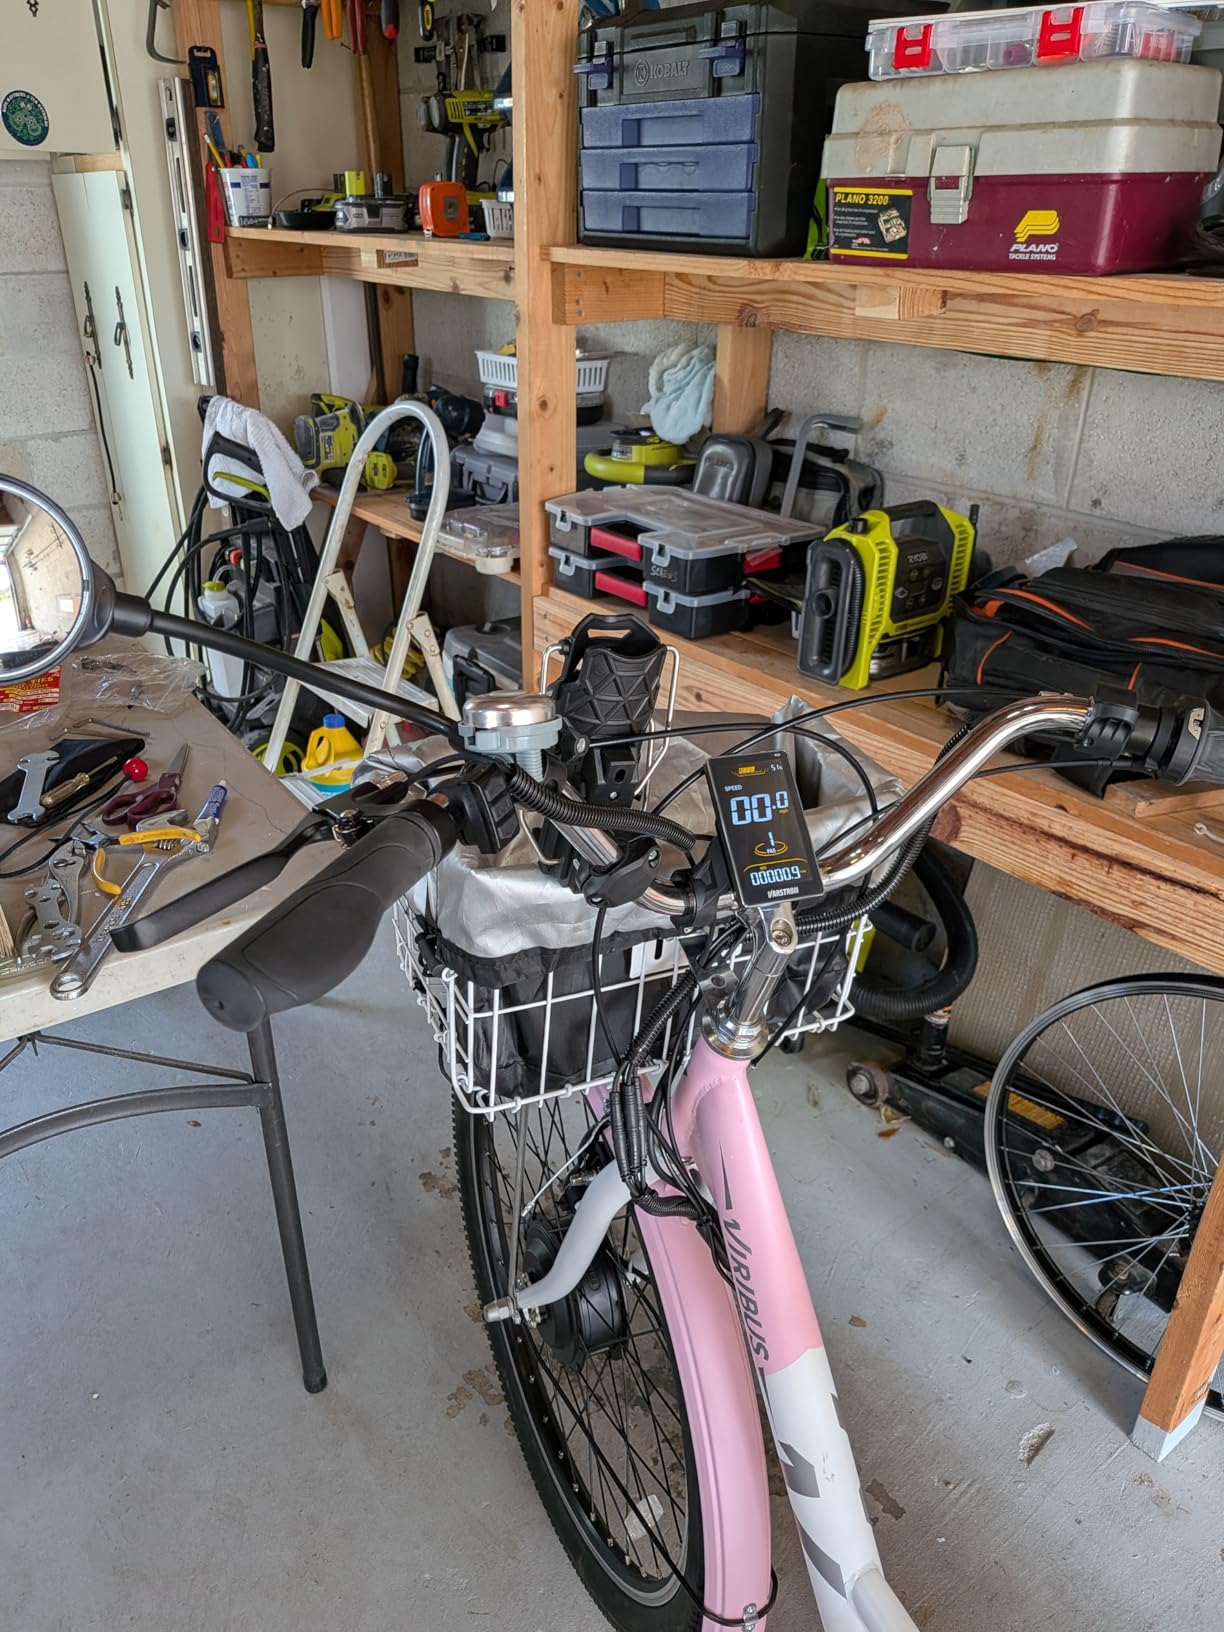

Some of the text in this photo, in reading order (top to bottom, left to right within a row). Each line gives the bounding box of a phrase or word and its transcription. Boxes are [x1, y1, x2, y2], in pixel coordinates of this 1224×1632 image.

[650, 61, 689, 80] KOBALT
[835, 193, 889, 206] PLANO 3200
[1010, 243, 1058, 253] PLANO
[1030, 253, 1057, 261] SYSTEMS
[724, 784, 743, 792] SPEED
[730, 790, 789, 826] 00.0
[723, 1218, 769, 1361] VIRIBUS
